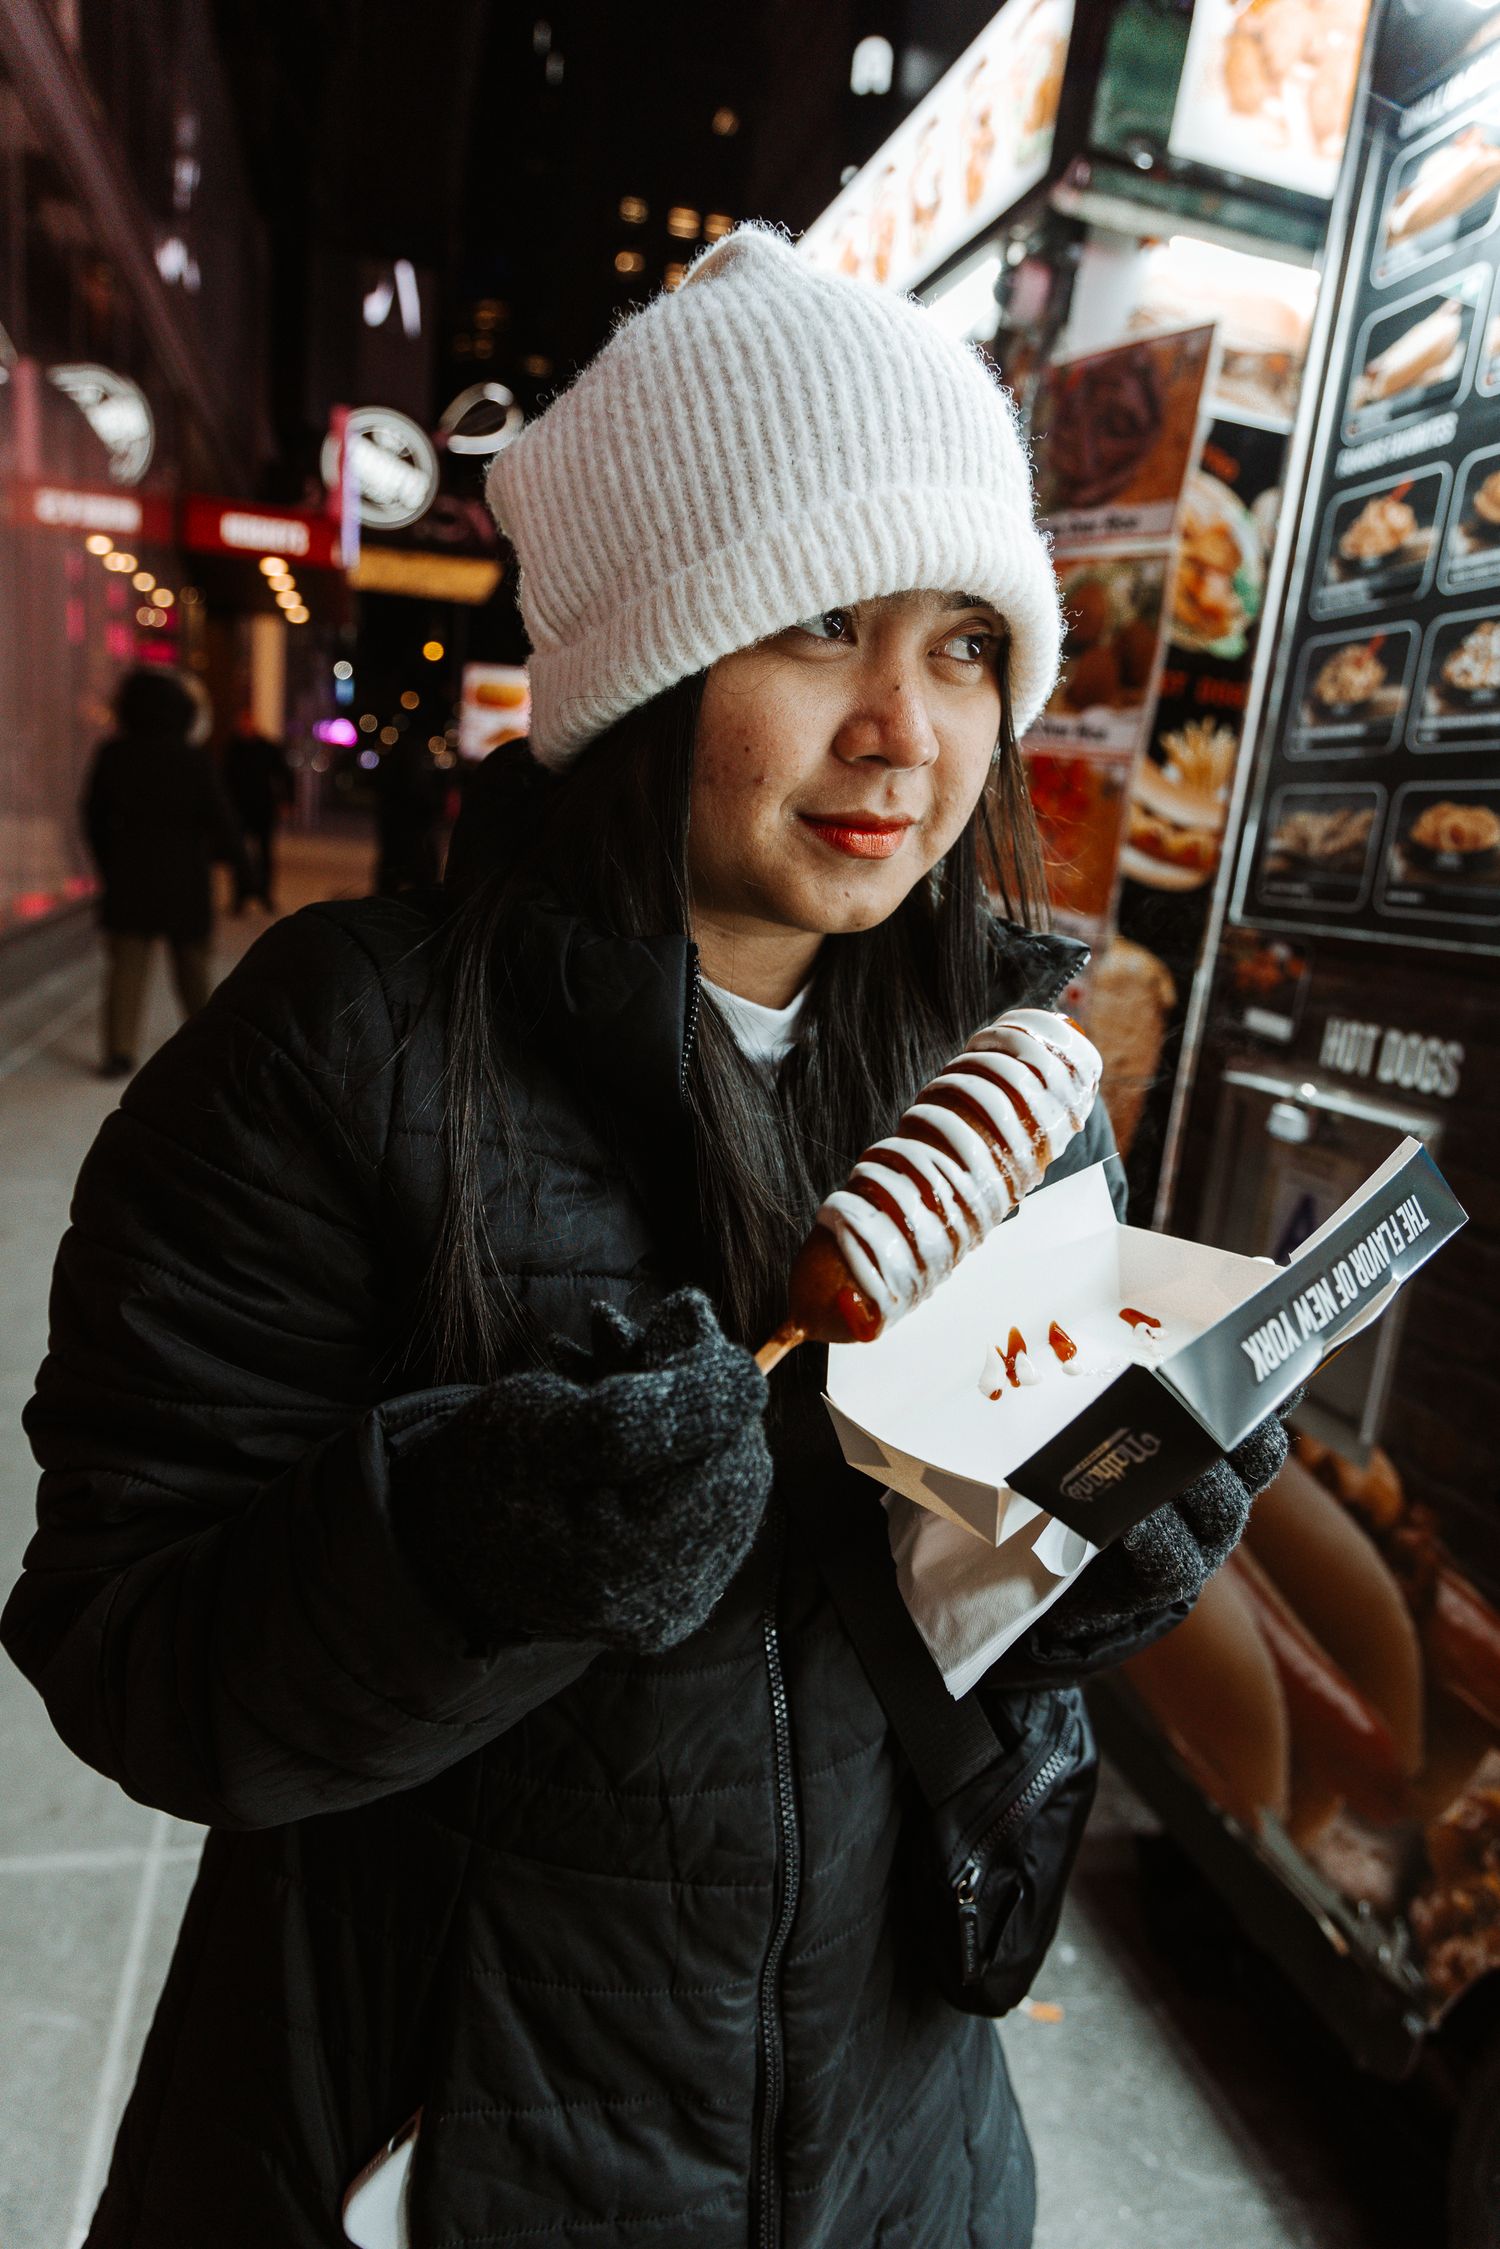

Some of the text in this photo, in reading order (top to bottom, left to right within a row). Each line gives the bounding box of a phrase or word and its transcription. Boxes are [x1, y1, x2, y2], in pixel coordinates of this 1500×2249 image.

[1320, 1017, 1380, 1077] HOT
[1377, 1028, 1464, 1097] DOGS
[1240, 1195, 1431, 1382] THE FLAVOR OF NEW YORK
